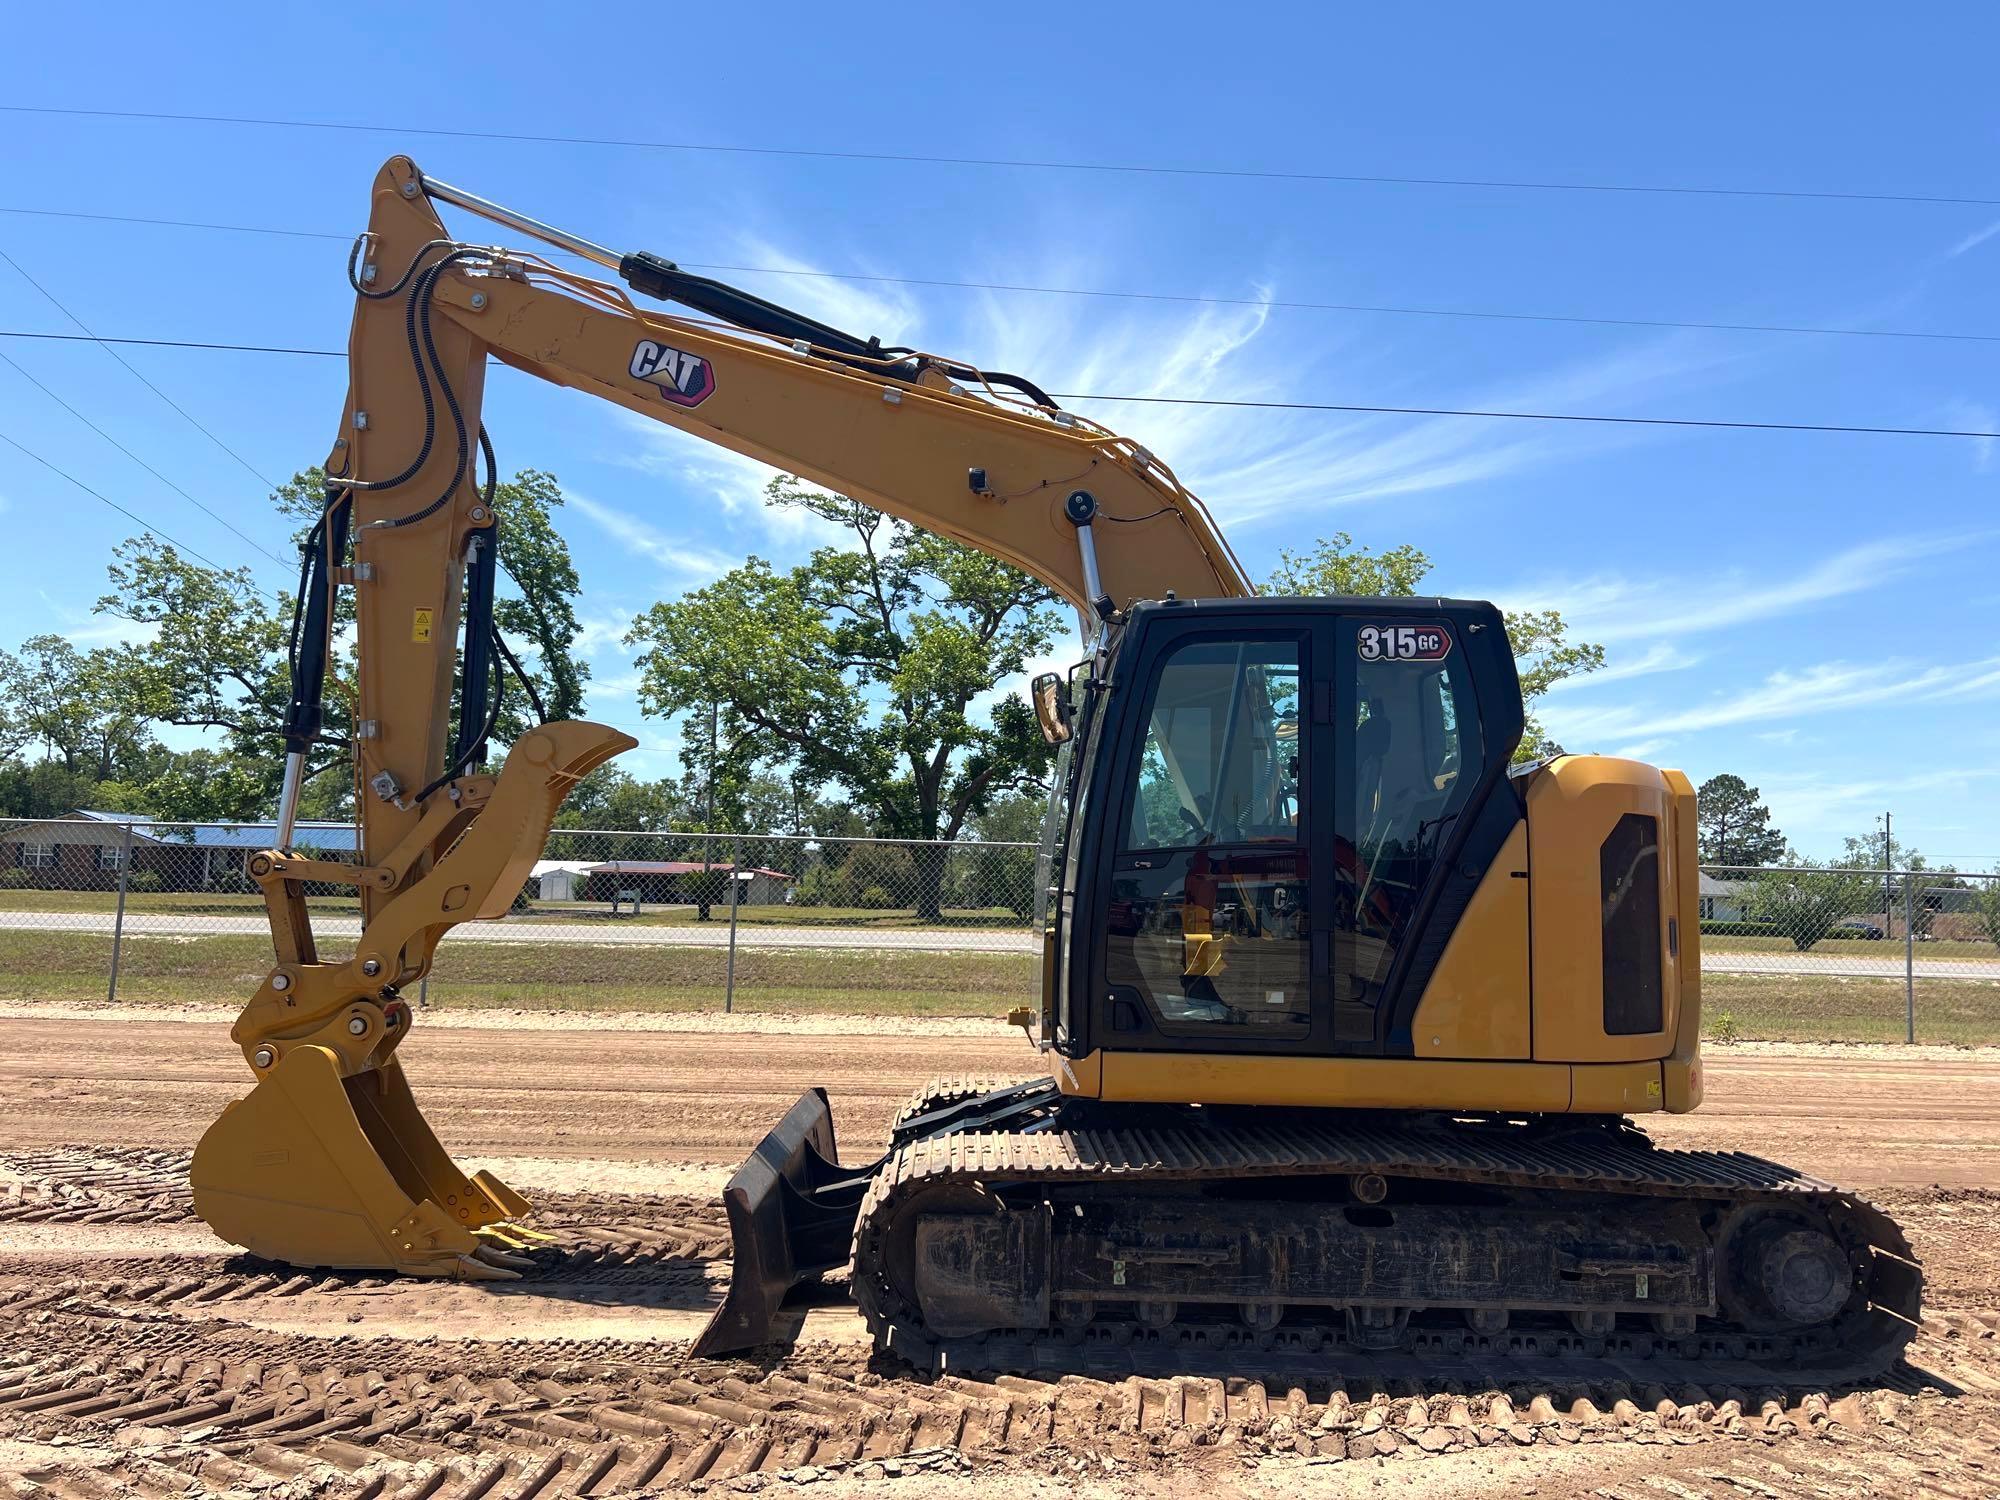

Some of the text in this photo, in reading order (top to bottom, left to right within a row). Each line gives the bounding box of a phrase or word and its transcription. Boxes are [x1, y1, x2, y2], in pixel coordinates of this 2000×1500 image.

[630, 340, 702, 393] CAT
[1360, 627, 1439, 658] 315 GC
